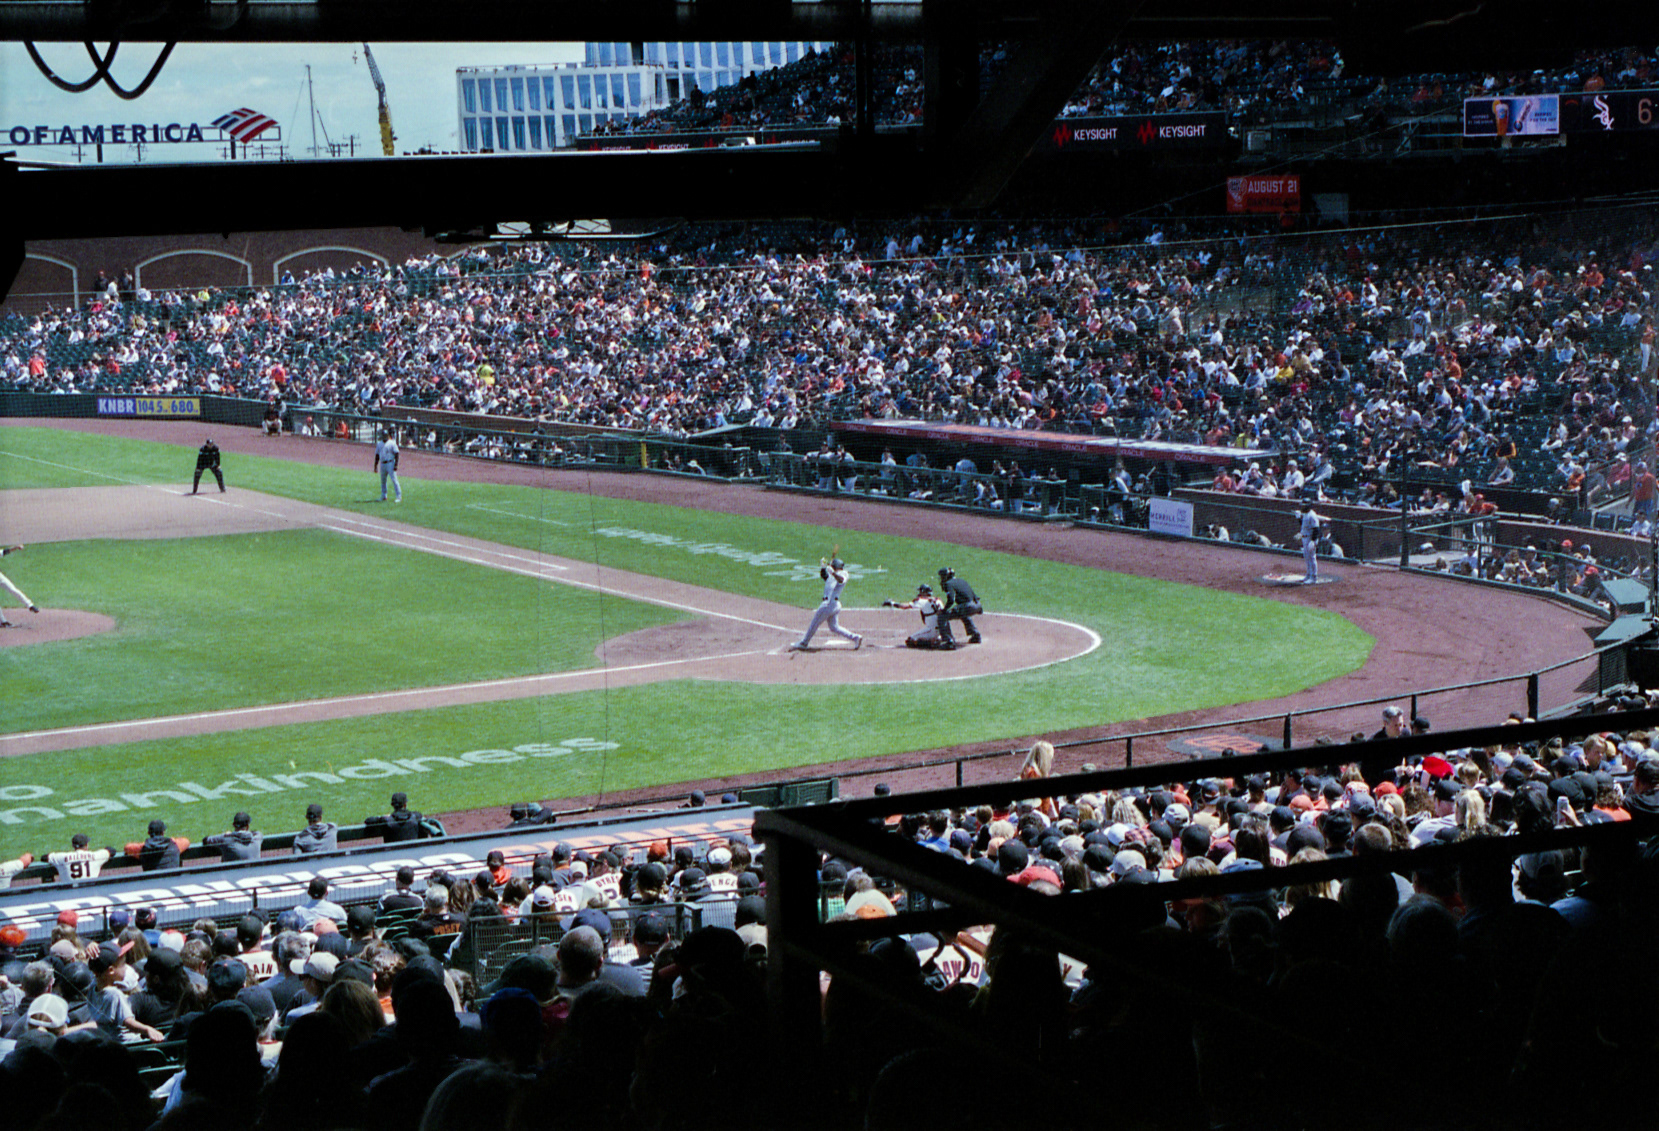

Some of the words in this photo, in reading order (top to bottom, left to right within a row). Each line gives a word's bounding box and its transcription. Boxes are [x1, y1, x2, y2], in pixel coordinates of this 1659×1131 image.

[1638, 98, 1652, 124] 6
[10, 125, 49, 145] OF
[59, 122, 204, 145] AMERICA
[1074, 128, 1118, 141] KEYSIGHT
[1159, 125, 1206, 138] KEYSIGHT
[1248, 180, 1284, 193] AUGUST
[1287, 180, 1298, 193] 21
[98, 398, 135, 413] KNBR
[171, 400, 194, 413] 680
[1015, 439, 1039, 448] ORACLE
[1061, 443, 1088, 452] ORACLE
[1174, 453, 1206, 463] ORACLE
[70, 860, 91, 879] 91
[253, 962, 273, 975] AIN
